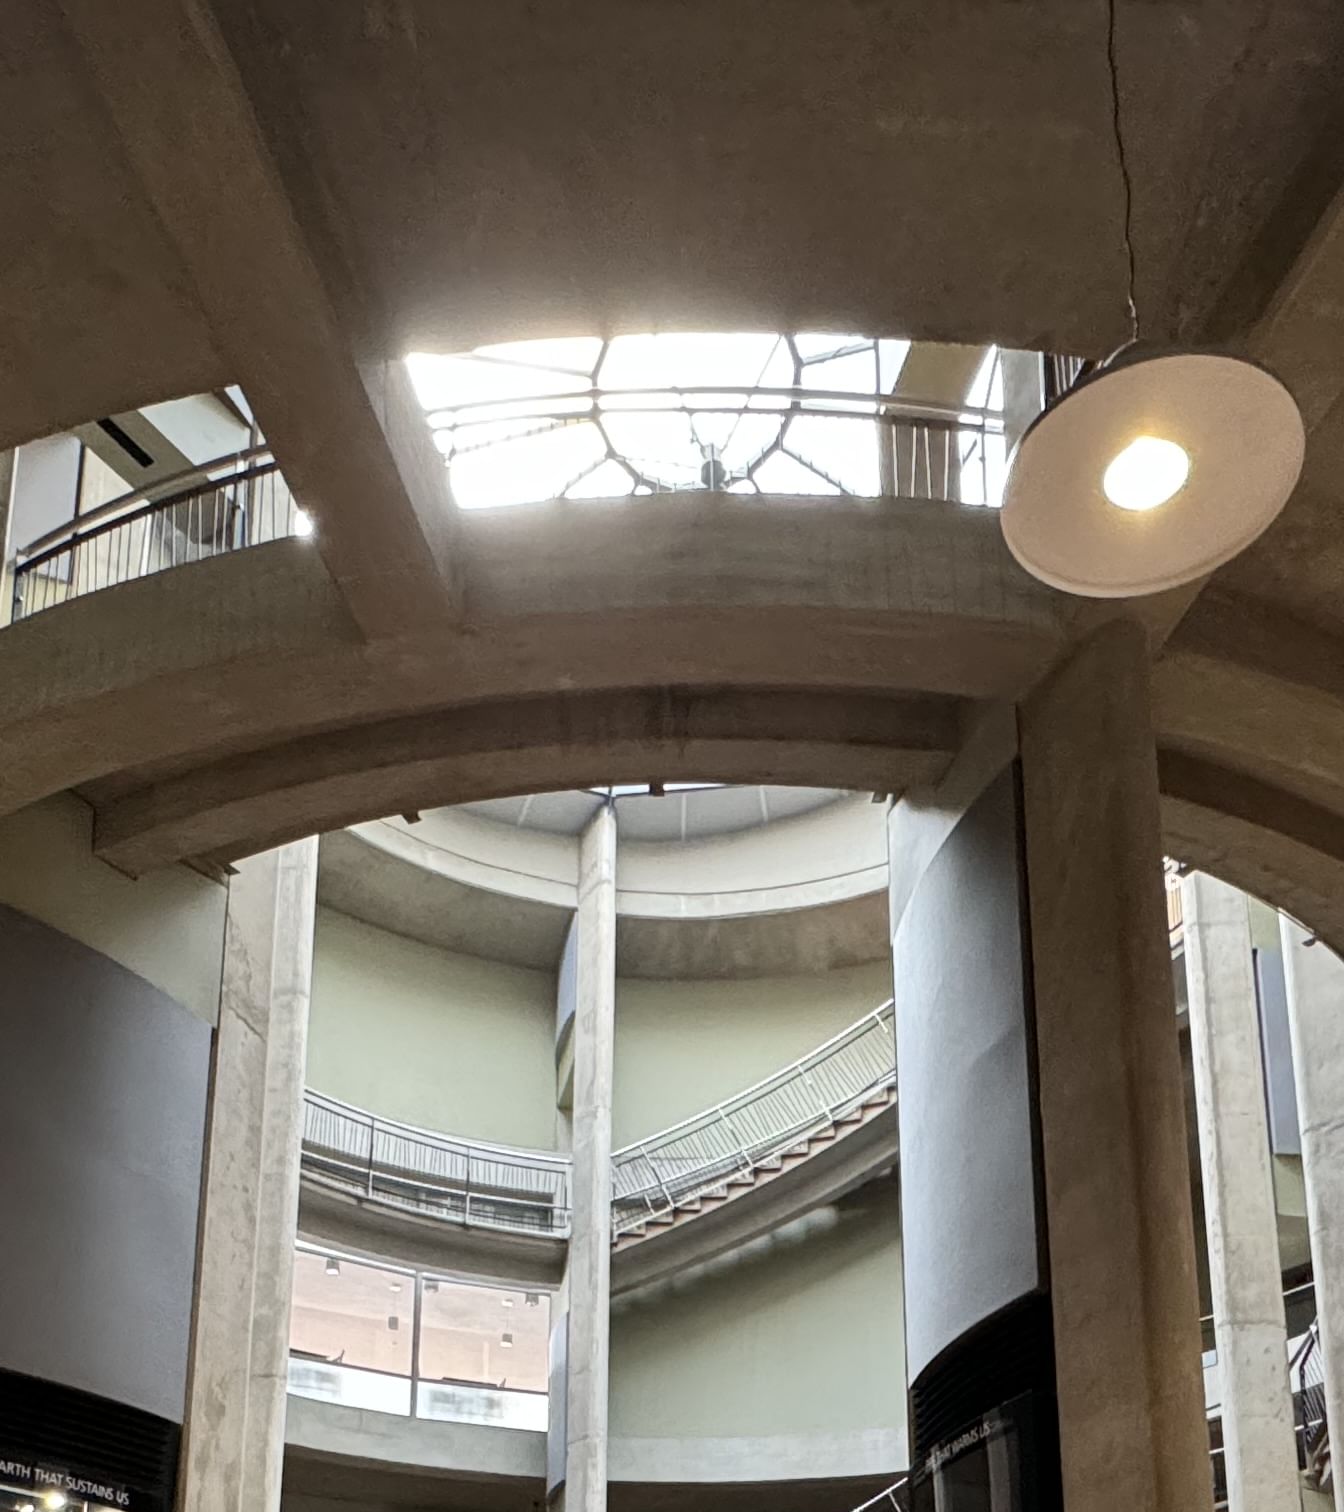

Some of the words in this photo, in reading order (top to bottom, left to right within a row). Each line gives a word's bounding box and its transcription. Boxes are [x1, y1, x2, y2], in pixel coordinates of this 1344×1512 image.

[34, 1468, 64, 1486] THAT
[65, 1475, 114, 1500] SUSTAINS
[116, 1490, 130, 1506] US
